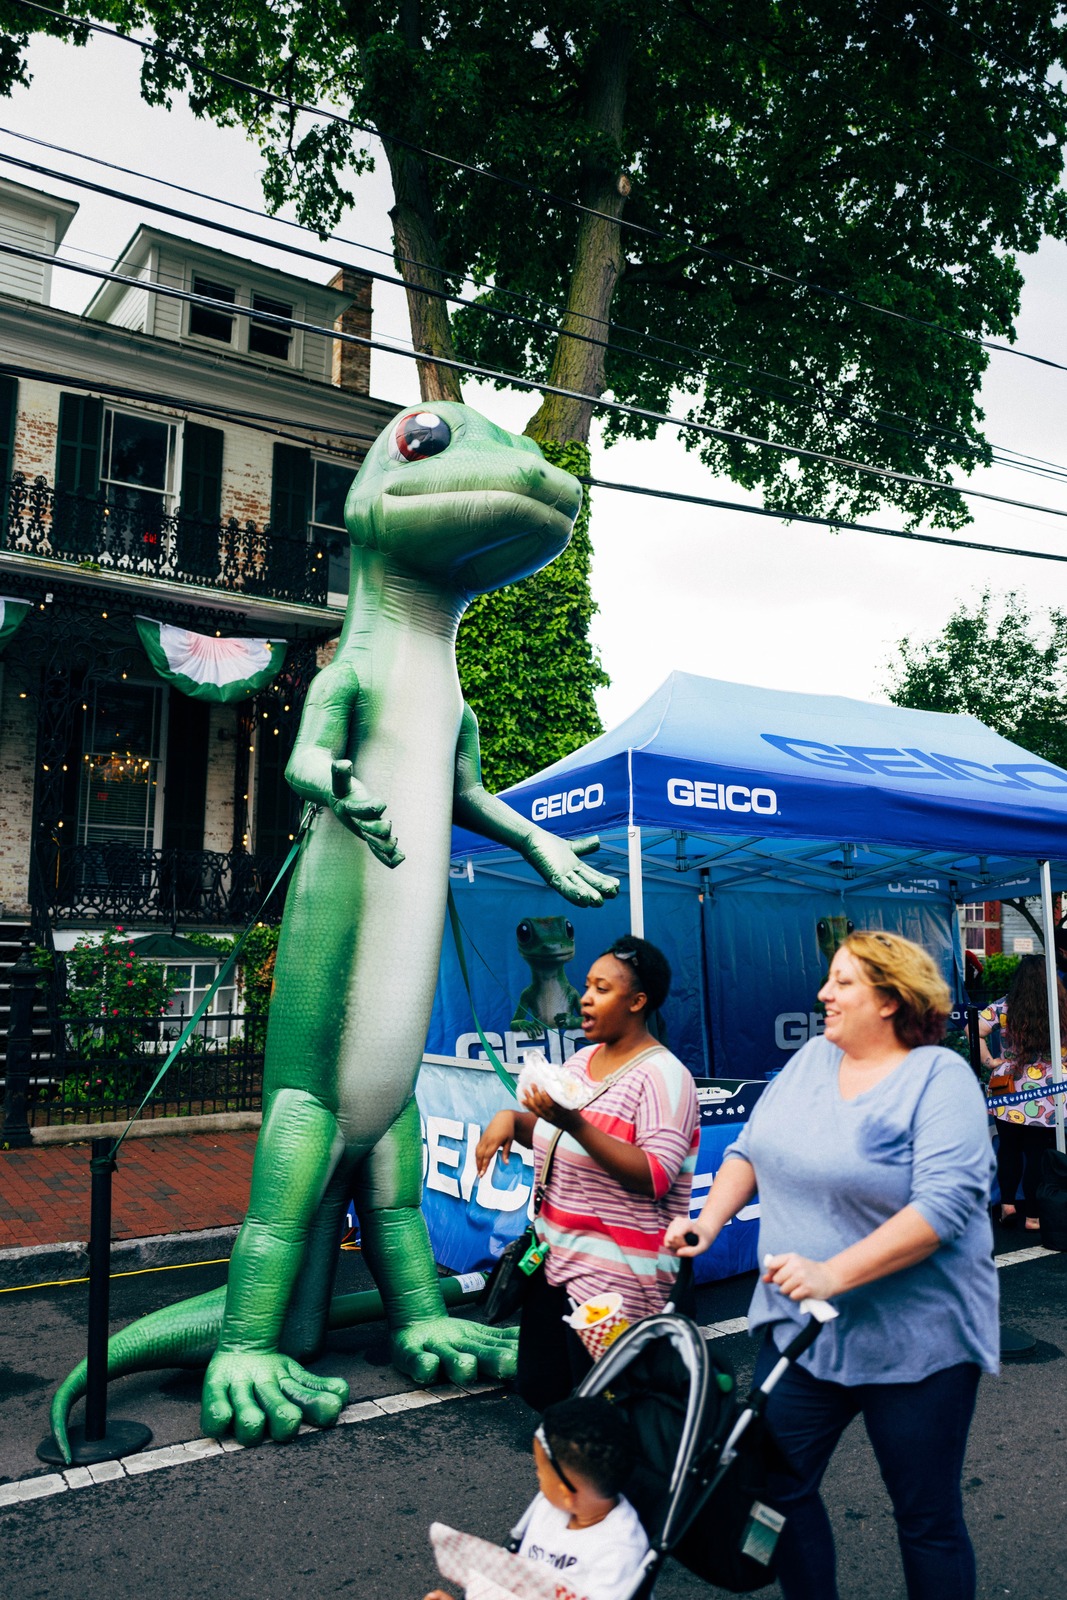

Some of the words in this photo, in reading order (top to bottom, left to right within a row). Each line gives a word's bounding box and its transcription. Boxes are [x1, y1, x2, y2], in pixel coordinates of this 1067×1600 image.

[760, 733, 1067, 794] GEICO
[531, 783, 604, 821] GEICO
[668, 778, 779, 815] GEICO
[420, 1115, 535, 1222] EIC
